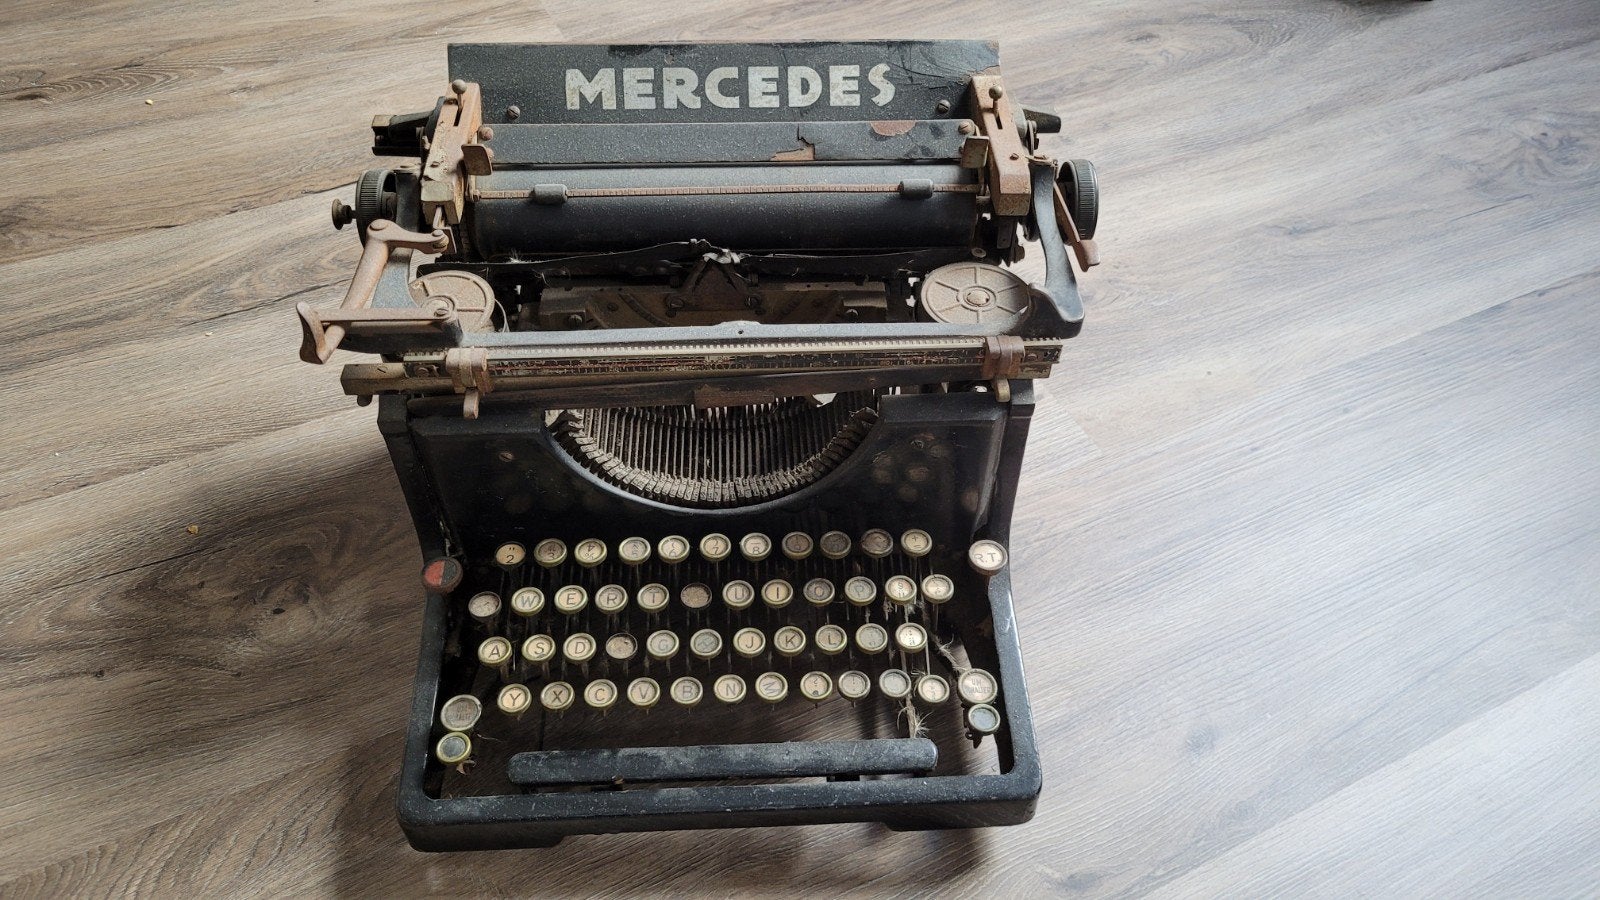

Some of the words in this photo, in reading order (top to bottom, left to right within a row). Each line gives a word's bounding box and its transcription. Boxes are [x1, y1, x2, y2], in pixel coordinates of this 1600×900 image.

[565, 63, 896, 111] MERCEDES
[505, 554, 515, 564] 2
[519, 595, 538, 608] W
[566, 592, 578, 606] E
[605, 592, 618, 605] R
[649, 590, 661, 604] T
[734, 586, 745, 601] U
[488, 643, 502, 659] A
[533, 642, 546, 656] S
[574, 641, 586, 655] D
[745, 636, 755, 650] J
[785, 634, 797, 648] K
[827, 632, 837, 646] L
[509, 691, 522, 707] Y
[551, 689, 564, 704] X
[594, 688, 606, 702] C
[638, 685, 650, 700] V
[682, 685, 694, 699] B
[725, 683, 736, 697] N
